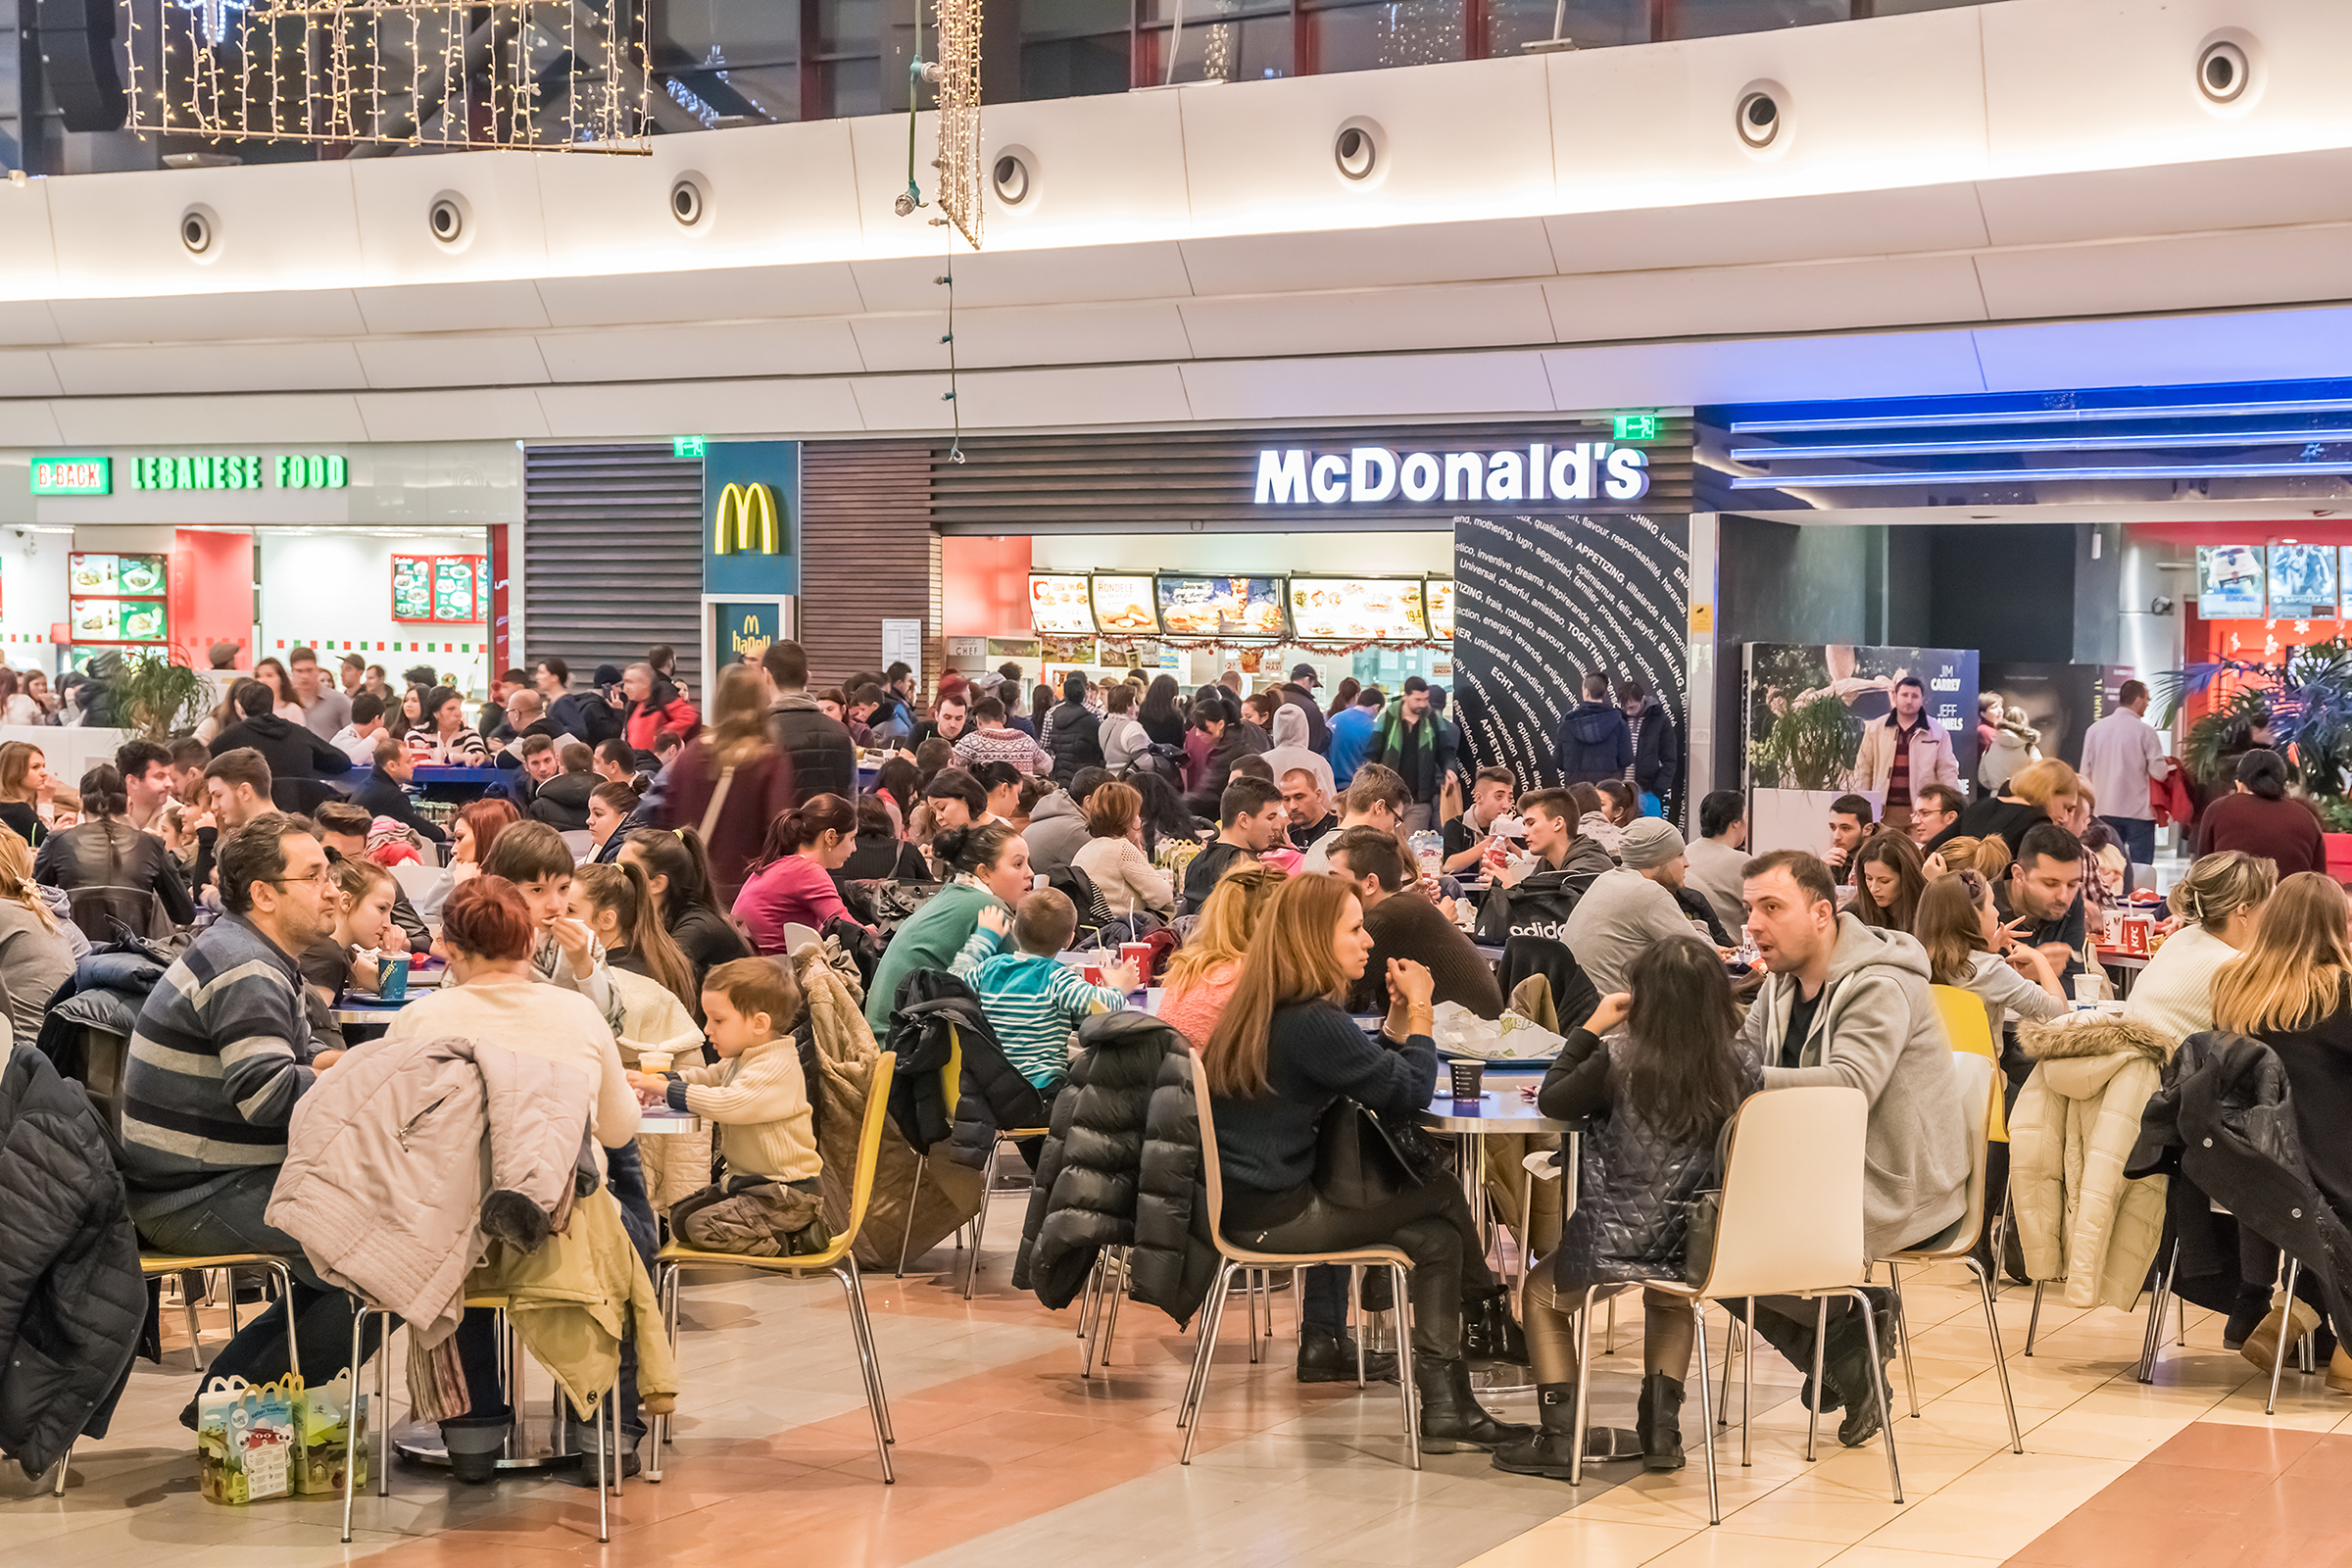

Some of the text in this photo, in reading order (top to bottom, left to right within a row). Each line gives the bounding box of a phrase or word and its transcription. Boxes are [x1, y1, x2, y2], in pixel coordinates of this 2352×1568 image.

[38, 464, 101, 488] B-BACK
[130, 454, 346, 490] LEBANESE FOOD
[1254, 442, 1649, 504] McDonald's
[1534, 518, 1574, 549] qualitative,
[1574, 542, 1626, 587] APPETIZING,
[1582, 515, 1610, 539] flavour,
[1610, 533, 1661, 582] responsabilité,
[1459, 558, 1497, 584] Universal,
[1498, 578, 1531, 604] cheerful,
[1531, 598, 1565, 628] amistoso,
[1567, 621, 1607, 672] TOGETHER
[1473, 516, 1514, 542] mothering,
[1515, 532, 1534, 553] lugn,
[1535, 546, 1573, 581] seguridad,
[1597, 604, 1635, 655] prospeccao,
[1634, 652, 1660, 689] comfort,
[1477, 548, 1513, 573] inventive,
[1514, 565, 1545, 590] dreams,
[1545, 581, 1591, 627] inspirerande,
[1591, 624, 1620, 663] colourful,
[1486, 595, 1504, 613] frais,
[1505, 607, 1535, 632] robusto,
[1536, 625, 1567, 656] savoury,
[1576, 563, 1686, 691] optimismus, feliz, playful, SMILING,
[956, 647, 978, 656] CHEF
[1454, 606, 1482, 623] action,
[1514, 633, 1543, 666] levande,
[1452, 657, 1467, 674] rity,
[1466, 670, 1492, 707] vertraut,
[1474, 636, 1511, 666] universell,
[1511, 659, 1545, 700] freundlich,
[1544, 696, 1562, 724] team,
[1491, 666, 1514, 694] ECHT,
[1512, 691, 1541, 732] auténtico,
[1939, 665, 1954, 677] JIM
[1936, 704, 1957, 716] JEFF
[1516, 721, 1538, 769] optimism,
[2131, 925, 2139, 948] KFC
